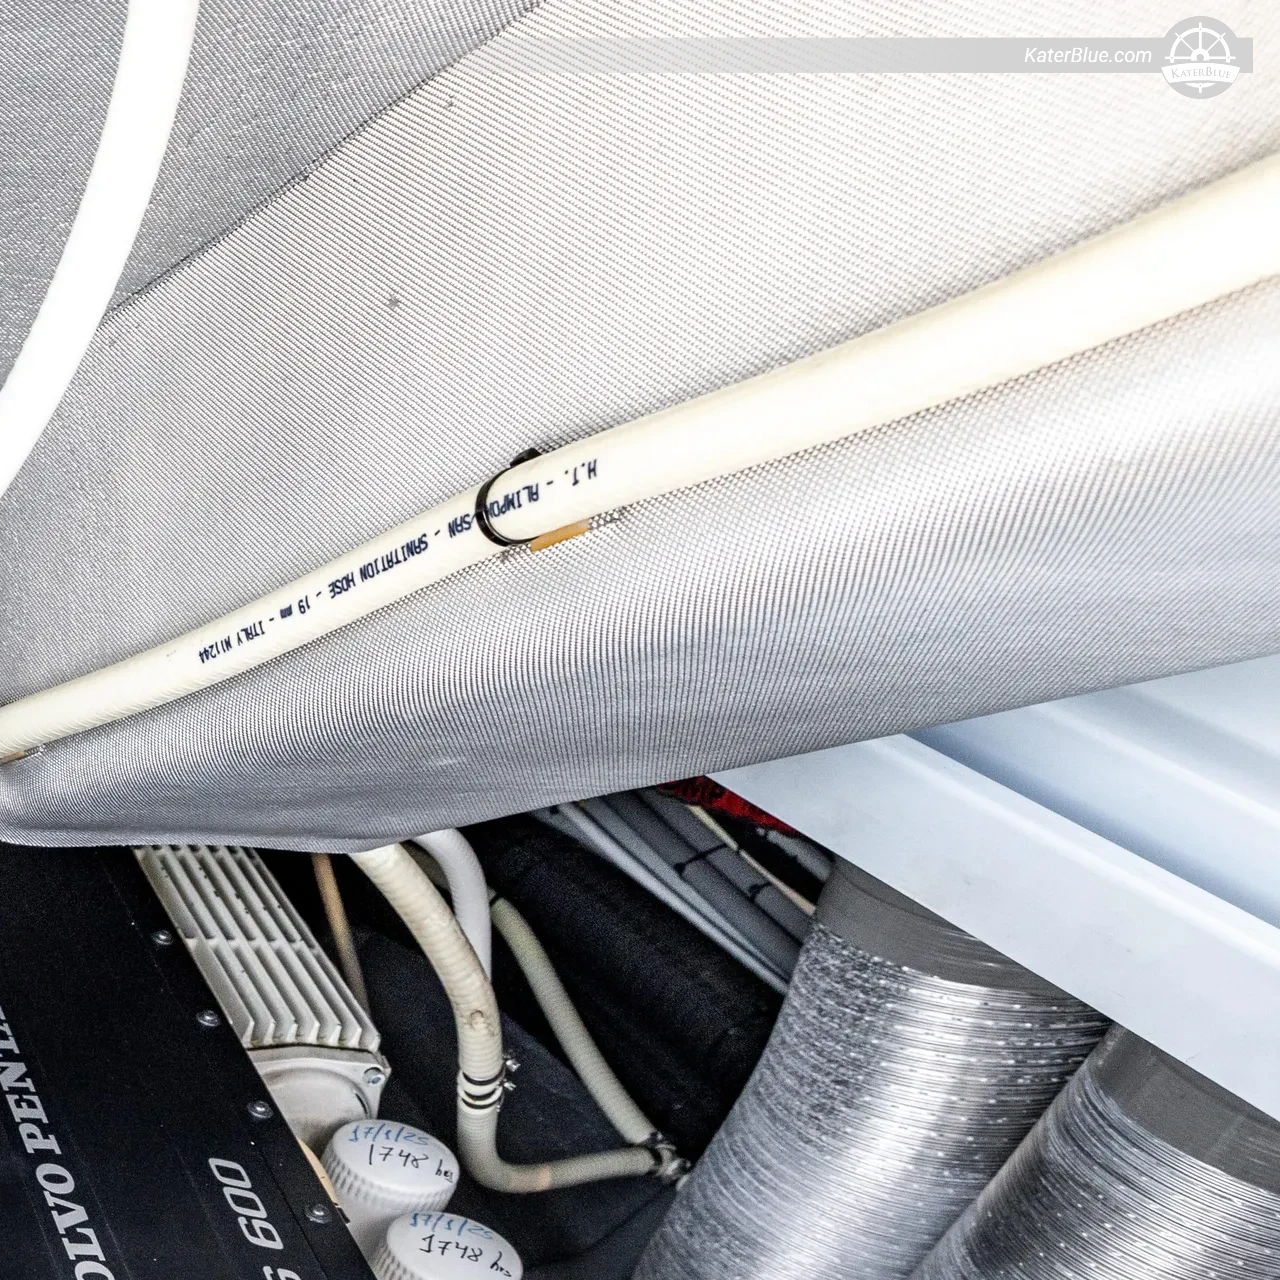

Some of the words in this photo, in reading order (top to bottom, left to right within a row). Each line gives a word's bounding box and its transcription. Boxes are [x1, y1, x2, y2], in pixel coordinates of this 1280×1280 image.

[359, 533, 429, 583] SANITATION
[328, 571, 356, 599] HOSE
[298, 595, 310, 614] 19
[236, 620, 265, 647] ITALY
[369, 1144, 429, 1168] 1748
[207, 1157, 284, 1250] 600
[419, 1233, 483, 1262] 1748
